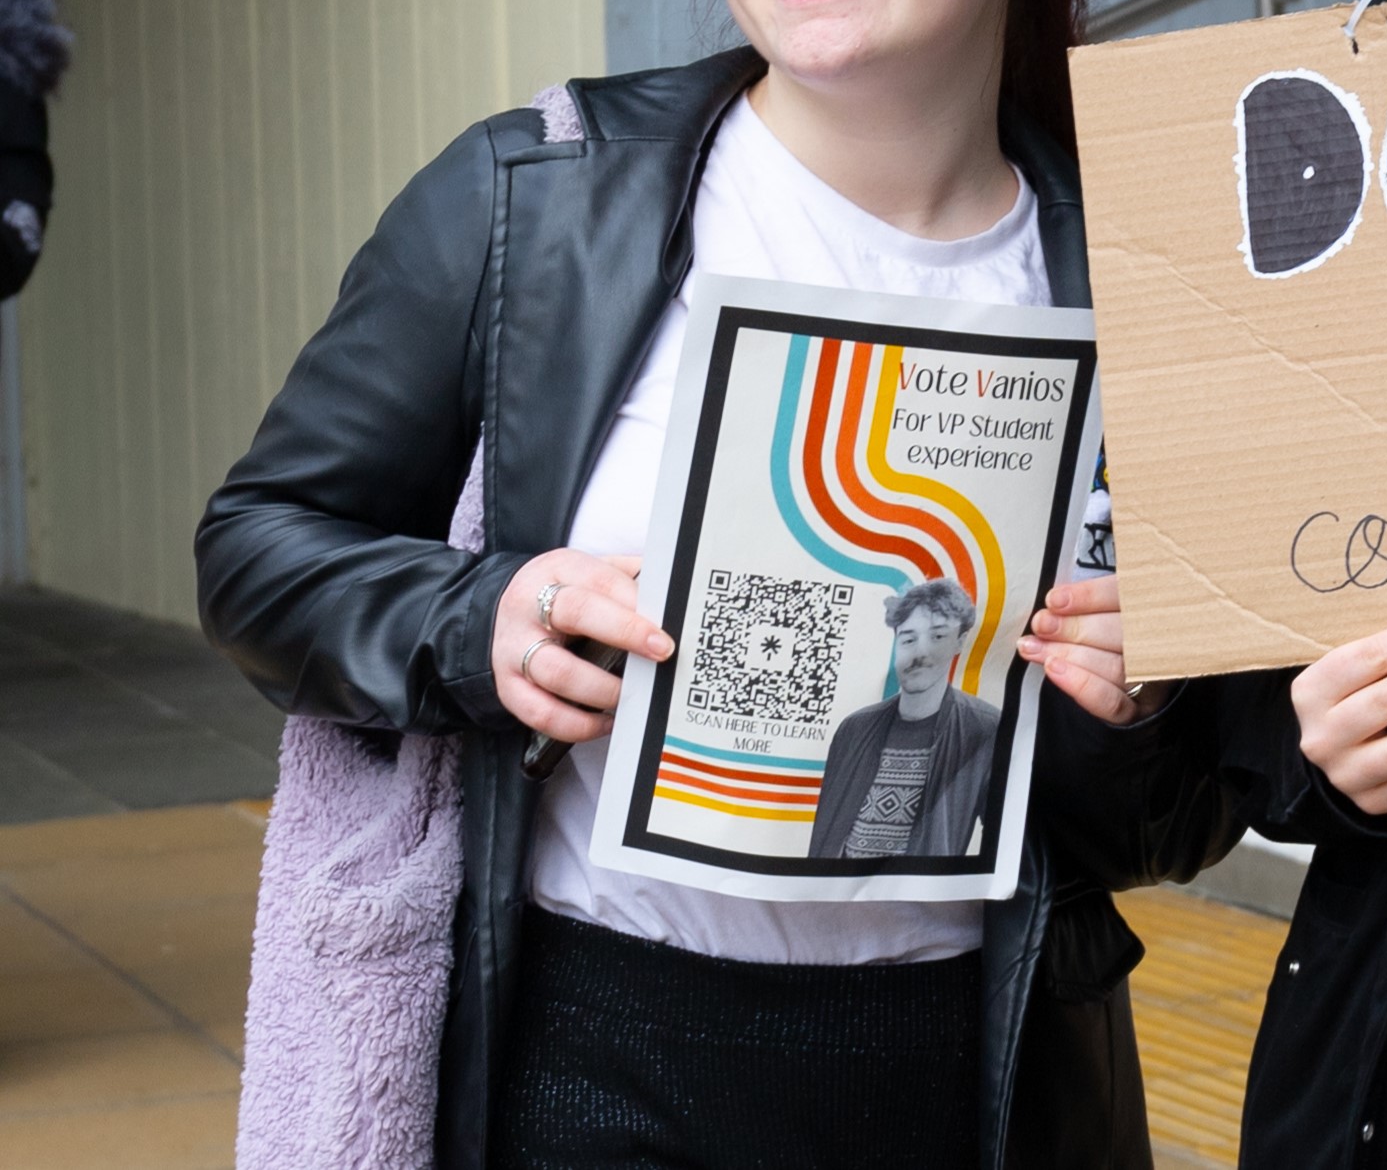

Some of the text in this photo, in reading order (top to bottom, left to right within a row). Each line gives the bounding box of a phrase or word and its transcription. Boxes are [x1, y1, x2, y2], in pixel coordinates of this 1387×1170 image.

[899, 362, 1066, 403] Vote Vanios
[892, 407, 1055, 441] For VP Student
[907, 444, 1033, 471] experience
[685, 709, 828, 742] SCAN HERE TO LEARN
[733, 736, 773, 754] MORE
